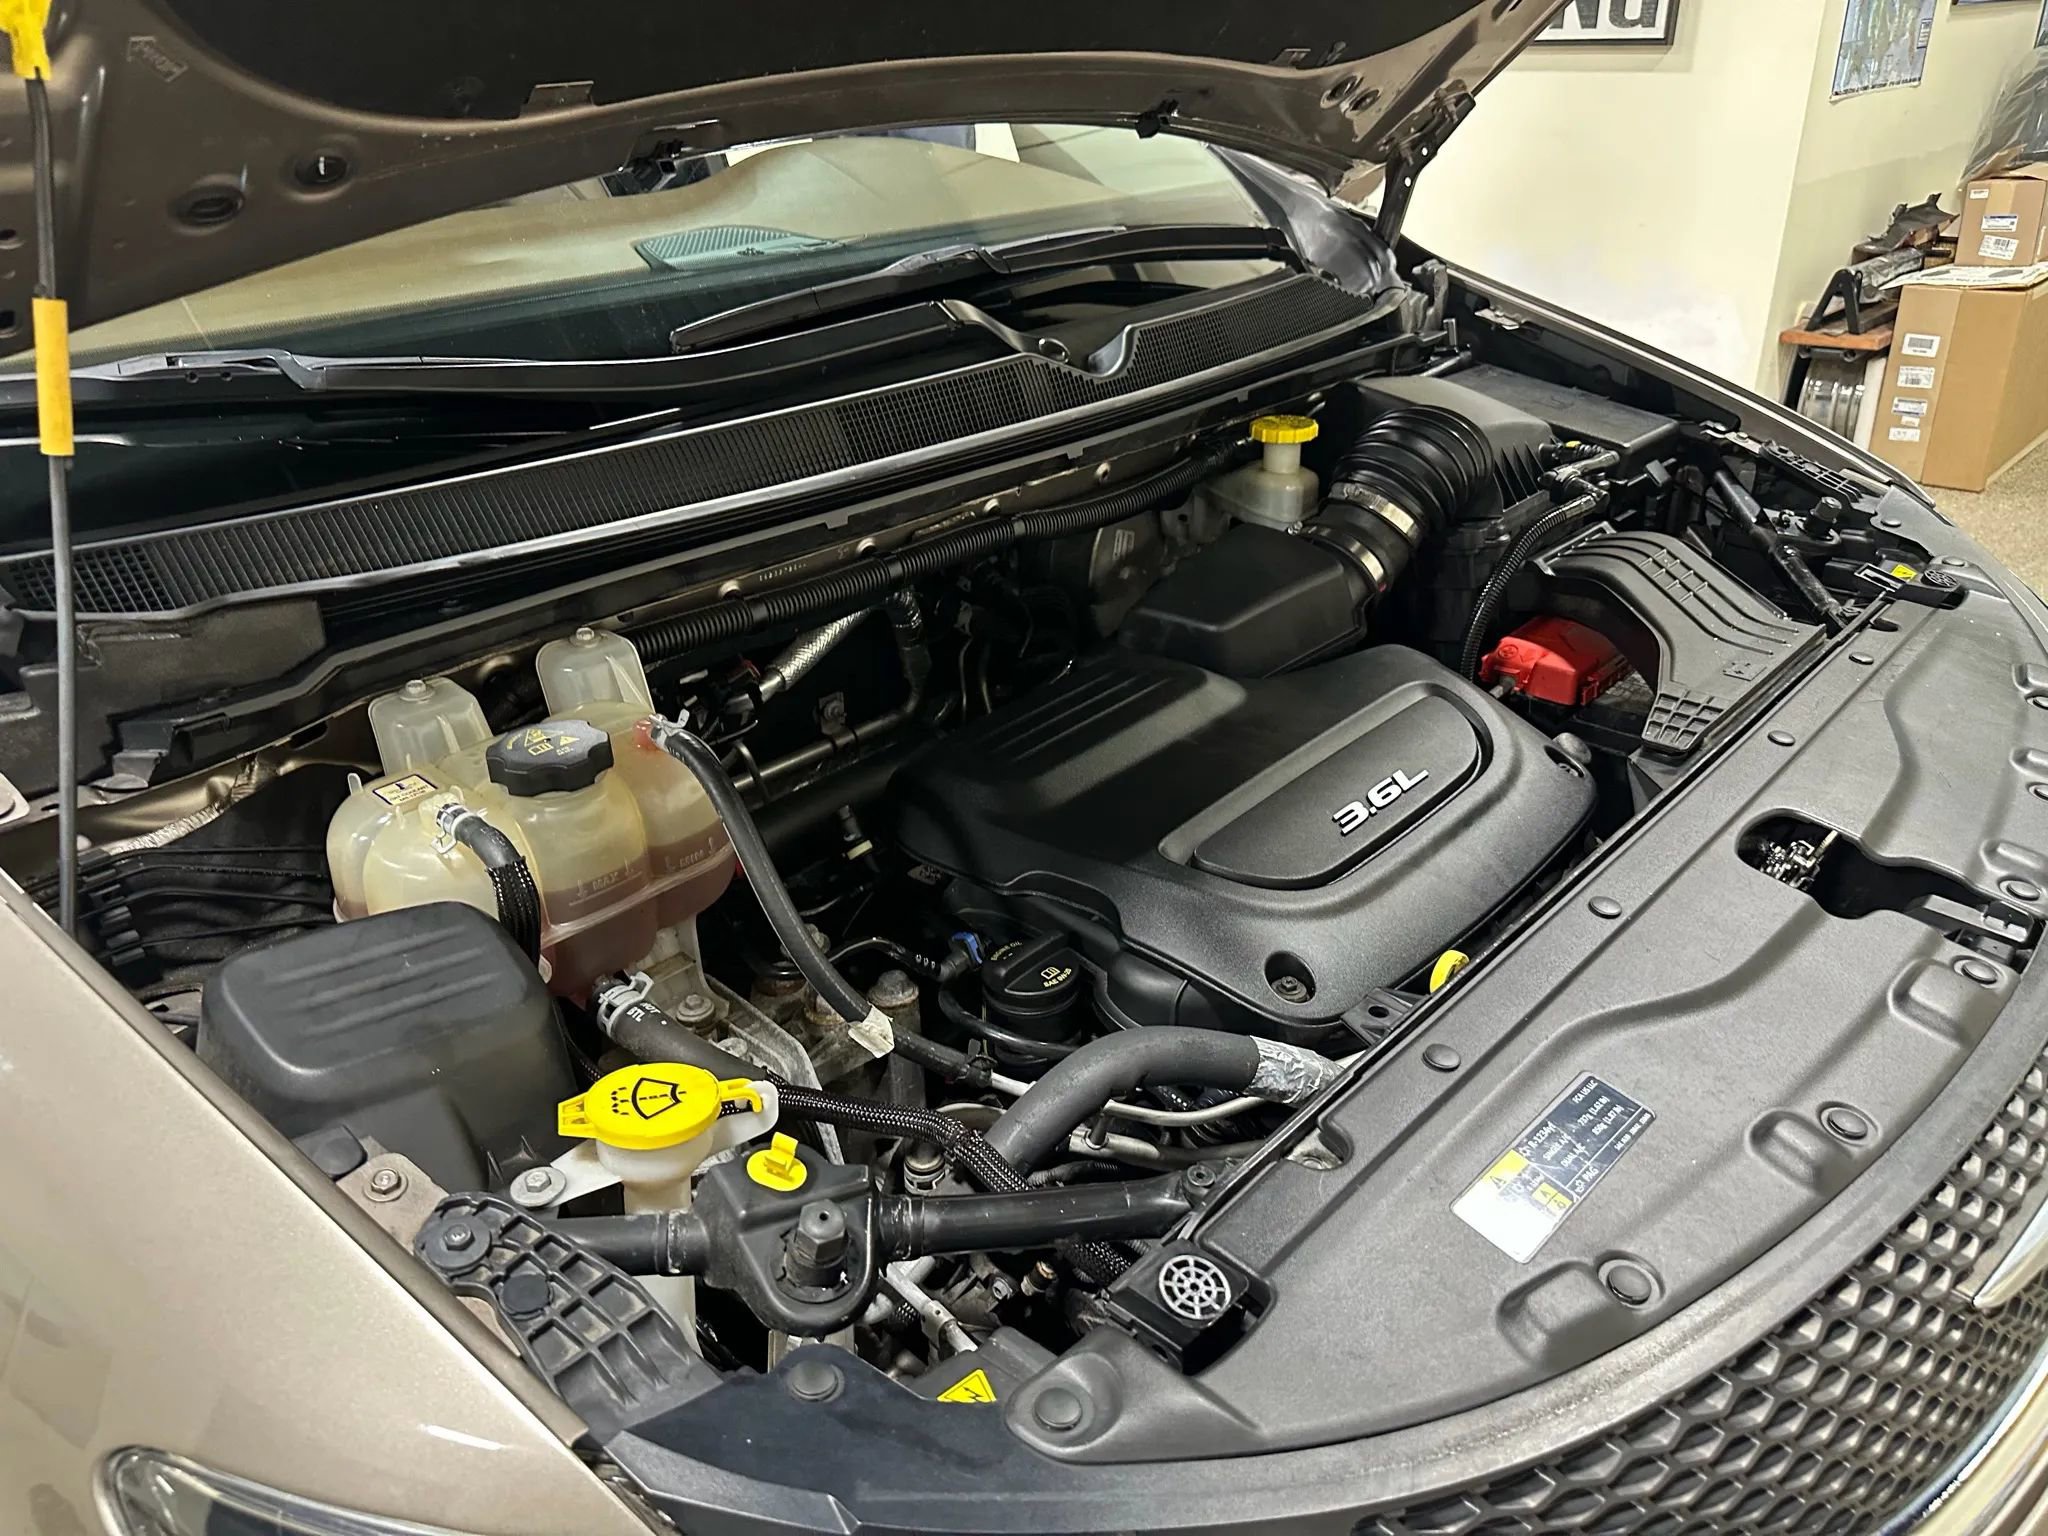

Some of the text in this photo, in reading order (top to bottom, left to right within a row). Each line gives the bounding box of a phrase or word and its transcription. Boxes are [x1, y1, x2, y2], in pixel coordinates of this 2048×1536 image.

[1332, 769, 1429, 836] 3.6L
[592, 871, 619, 890] MAX
[1043, 978, 1059, 988] SAE
[1561, 1152, 1576, 1167] DUAL
[1583, 1166, 1599, 1181] PAG
